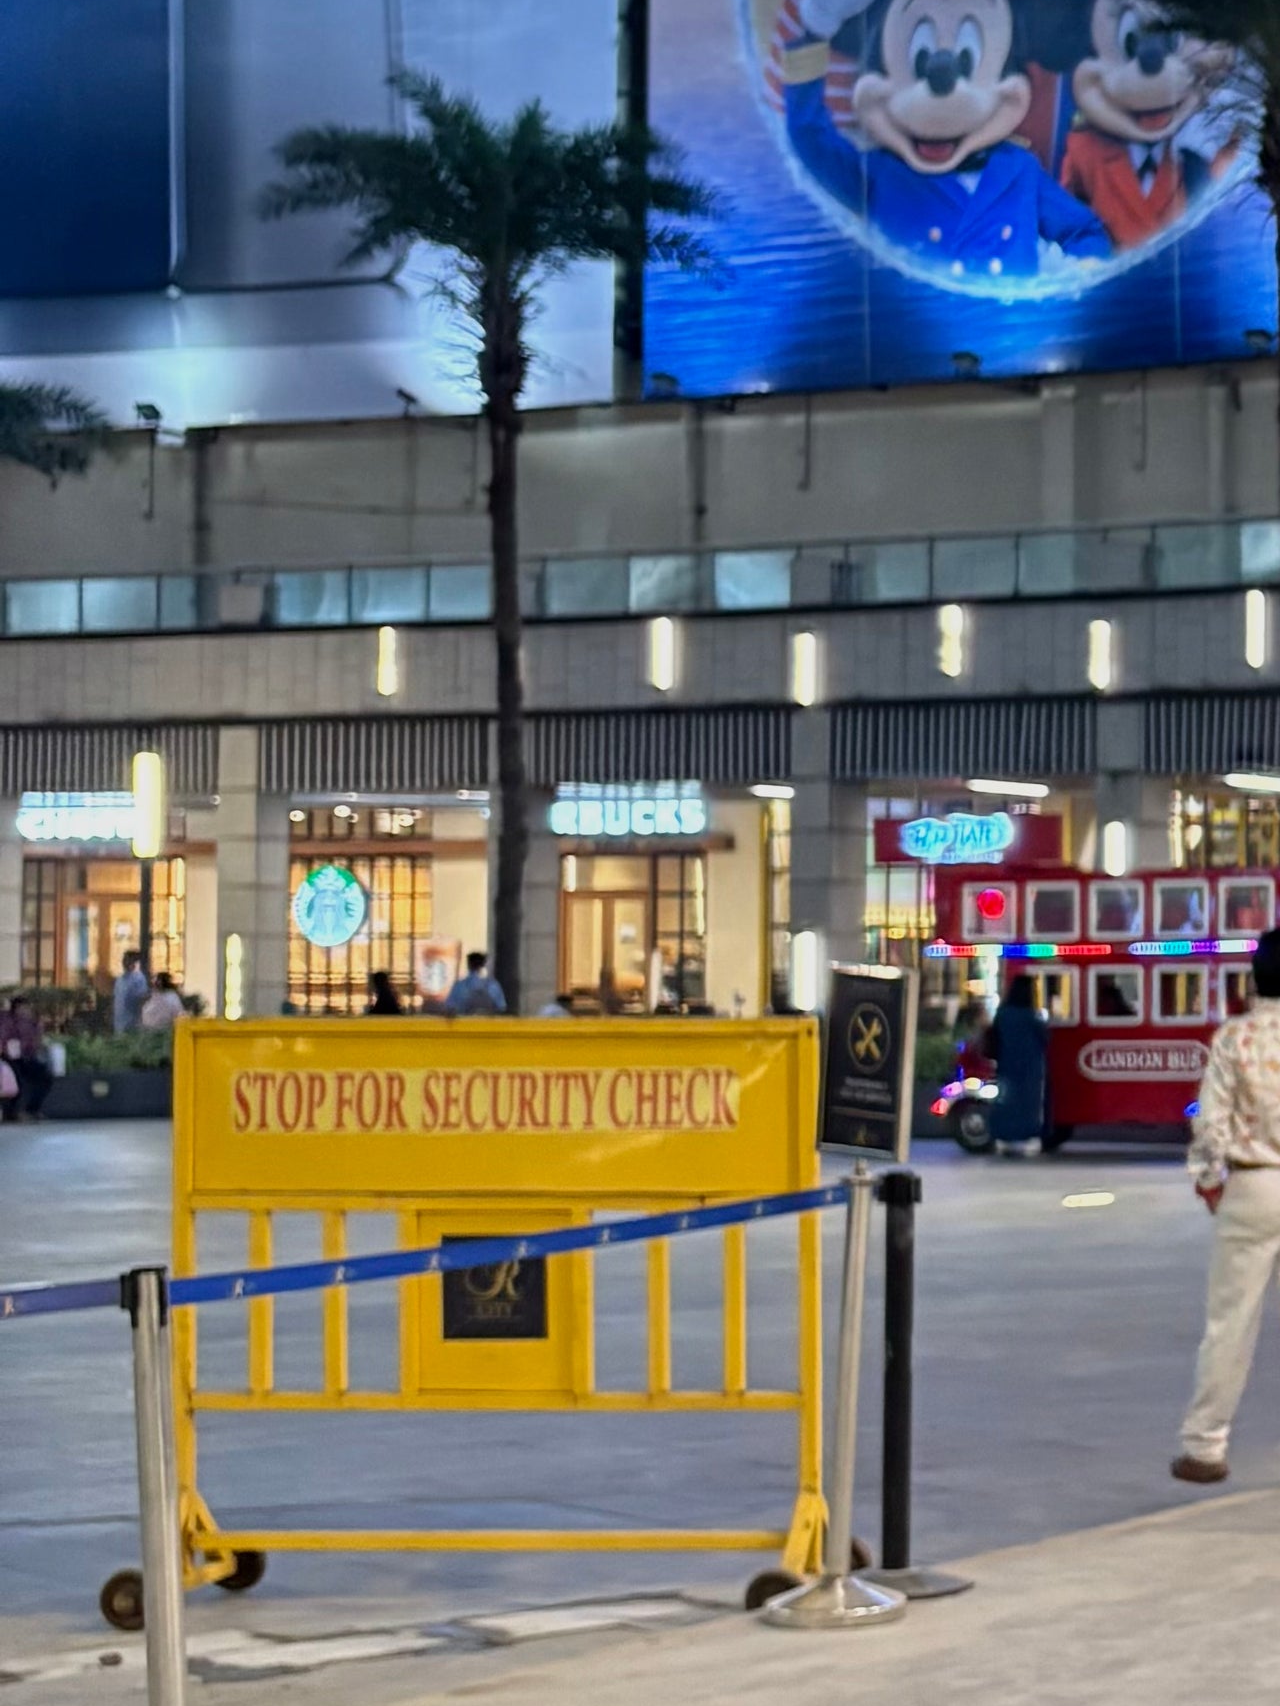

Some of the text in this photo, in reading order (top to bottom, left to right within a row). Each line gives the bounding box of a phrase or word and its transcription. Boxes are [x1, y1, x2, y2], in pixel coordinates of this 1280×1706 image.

[1091, 1050, 1162, 1069] LONDON
[234, 1068, 739, 1132] STOP FOR SECURITY CHECK
